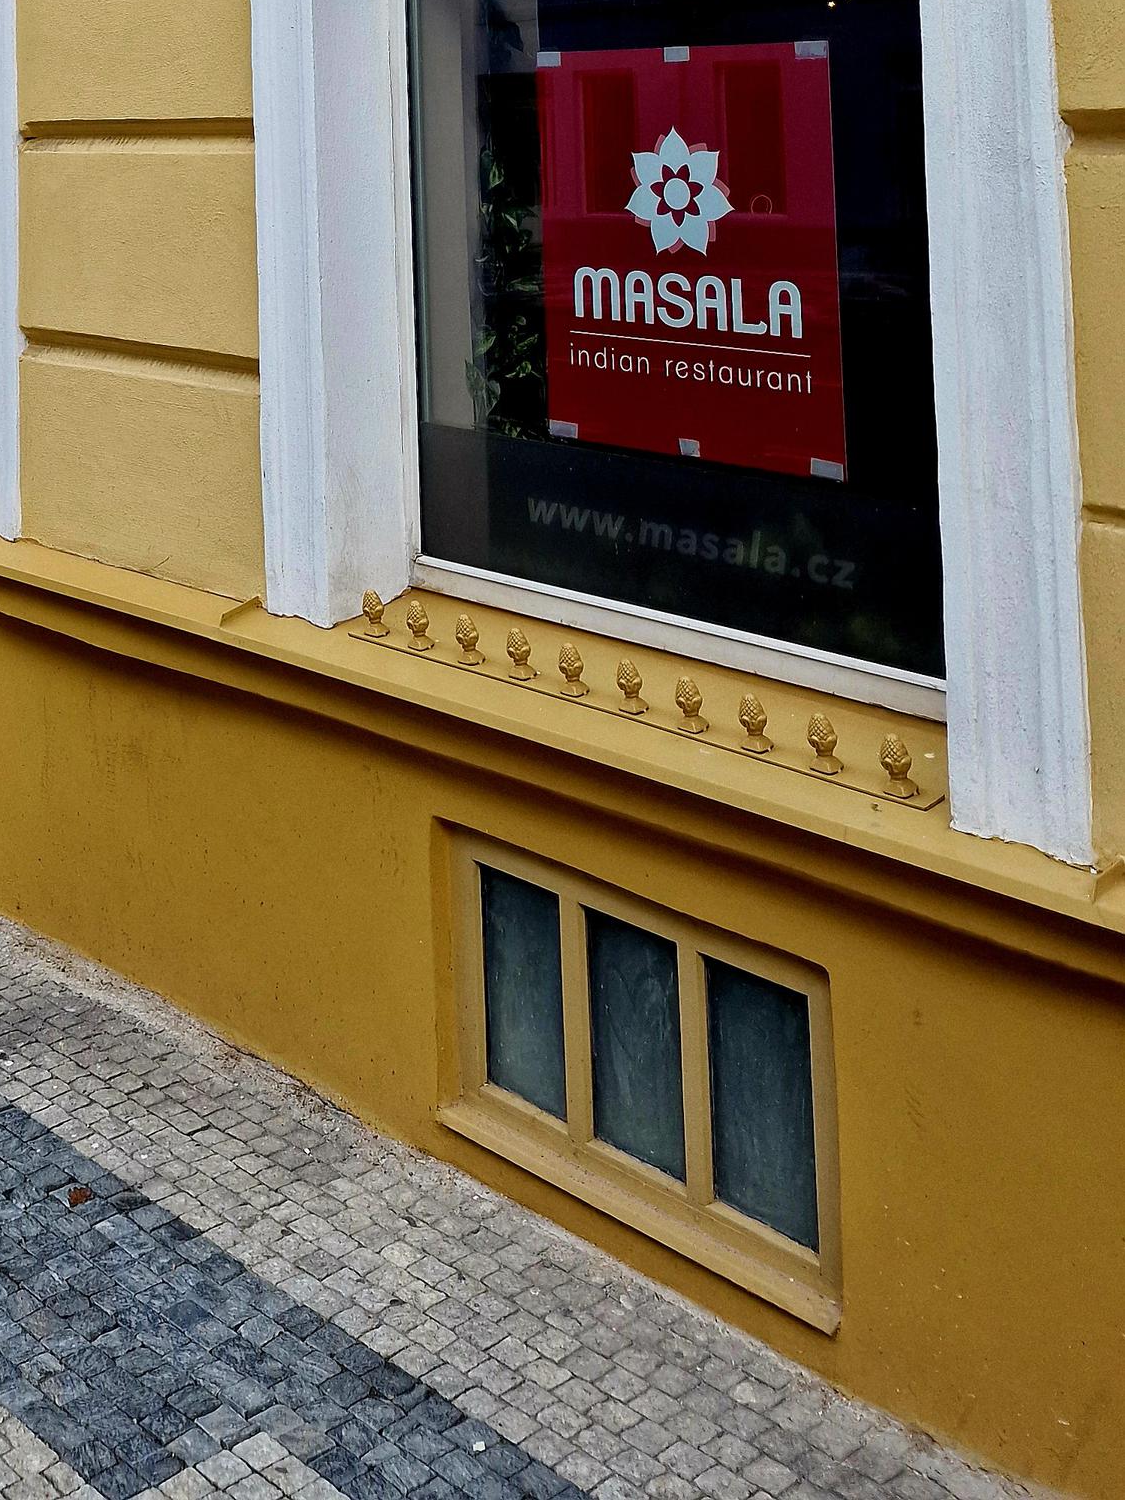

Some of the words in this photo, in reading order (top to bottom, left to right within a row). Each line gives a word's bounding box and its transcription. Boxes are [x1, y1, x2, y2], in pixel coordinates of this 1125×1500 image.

[573, 266, 804, 339] MASALA
[569, 342, 651, 375] indian
[664, 358, 813, 395] restaurant
[527, 497, 857, 589] www.masala.cz
